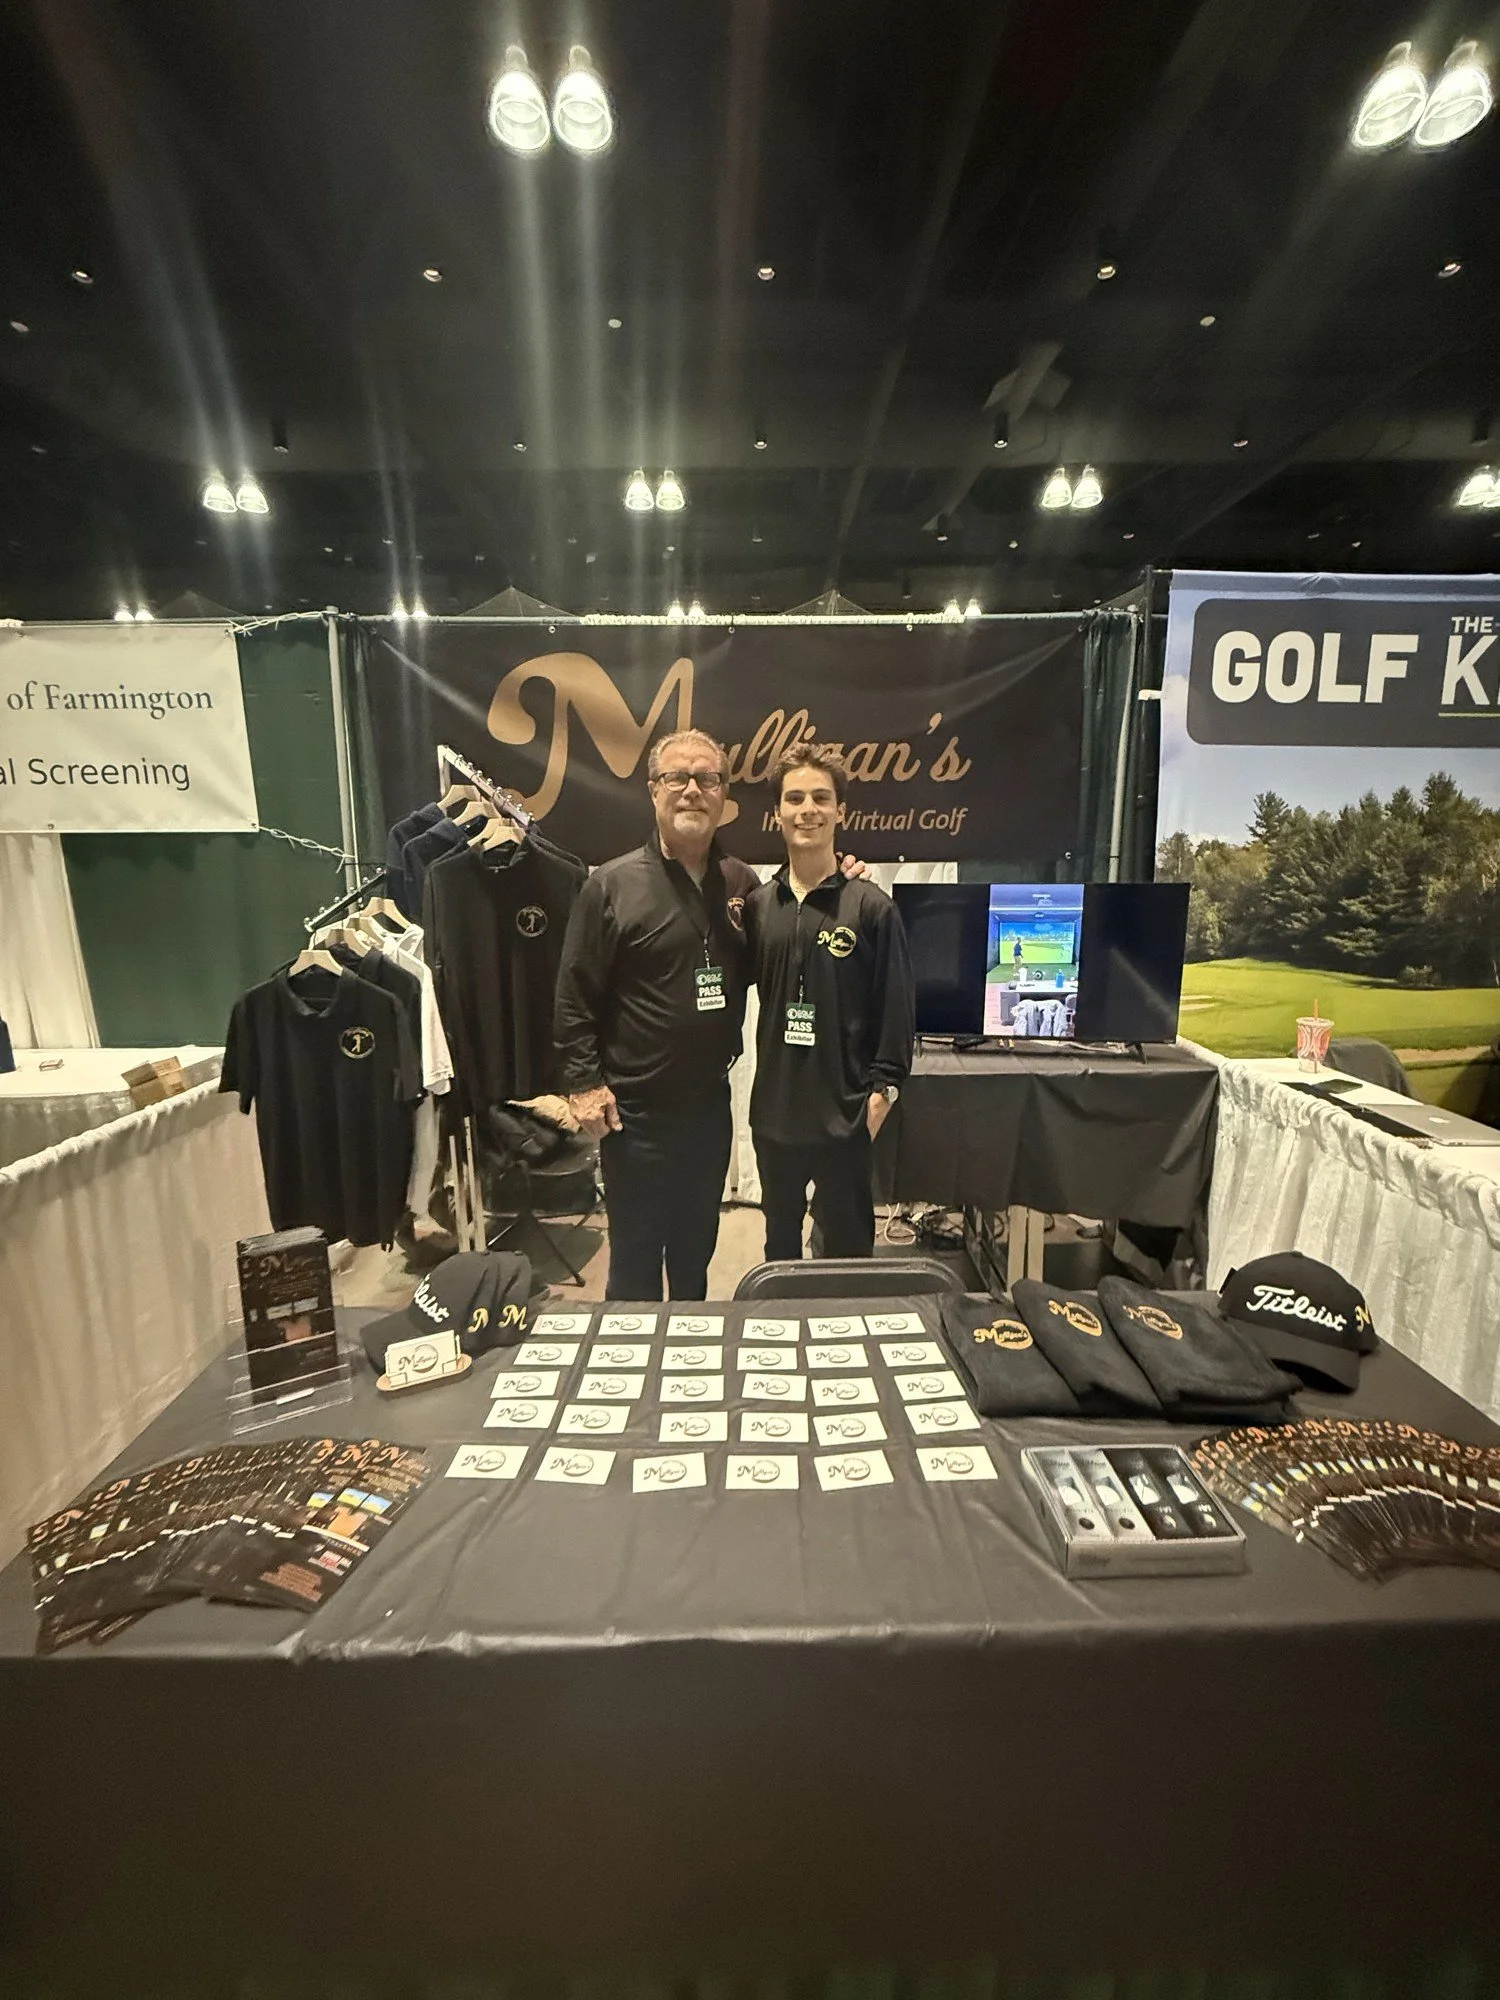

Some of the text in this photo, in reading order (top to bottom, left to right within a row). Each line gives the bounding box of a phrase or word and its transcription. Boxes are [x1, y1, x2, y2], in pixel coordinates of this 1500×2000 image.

[1451, 616, 1494, 633] THE
[1211, 630, 1500, 705] GOLF K
[7, 681, 213, 719] of Farmington
[487, 652, 972, 827] Mullan's
[28, 757, 190, 791] Screening
[841, 807, 968, 836] Virtual Golf
[699, 985, 722, 997] PASS
[788, 1020, 812, 1032] PASS
[498, 1304, 527, 1331] M
[1246, 1285, 1347, 1332] Titleist
